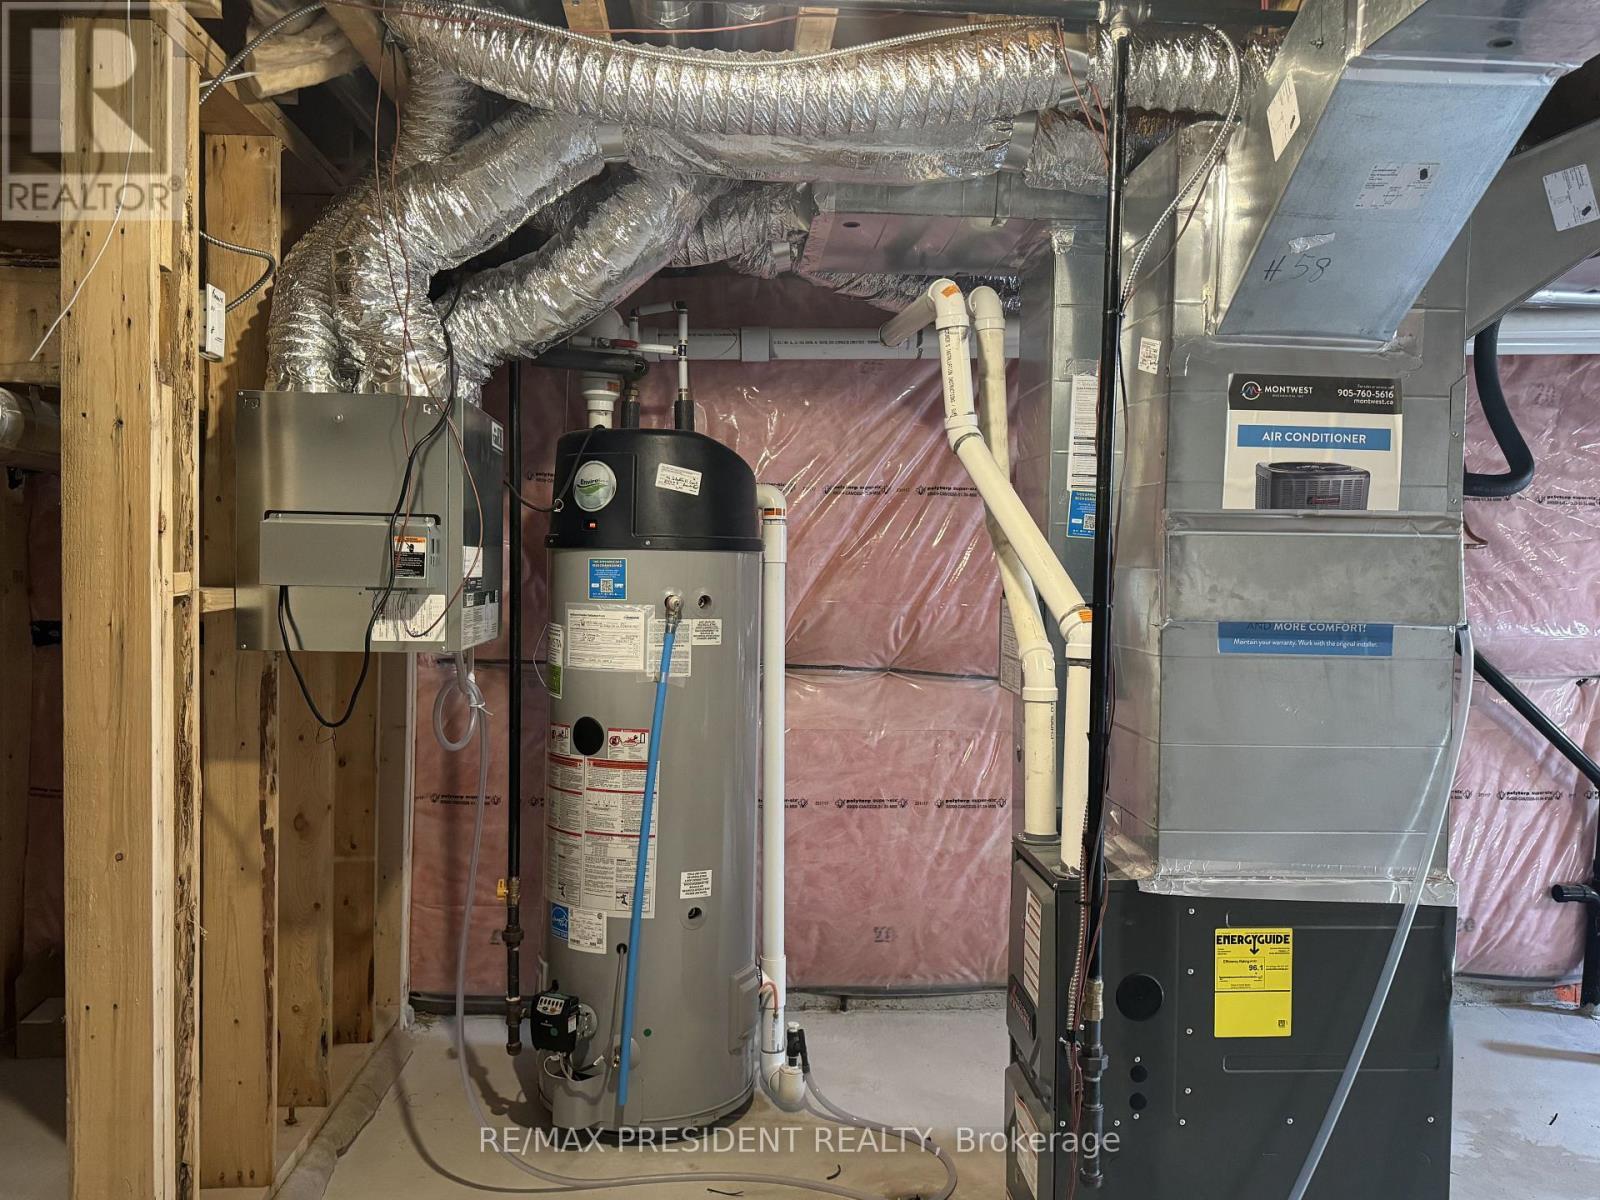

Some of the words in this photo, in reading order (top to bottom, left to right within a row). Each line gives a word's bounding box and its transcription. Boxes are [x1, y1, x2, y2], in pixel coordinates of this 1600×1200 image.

[1264, 385, 1313, 394] MONTWEST
[1337, 388, 1394, 399] 905-760-5616
[1262, 432, 1282, 442] AIR
[1284, 432, 1367, 444] CONDITIONER
[1274, 623, 1307, 631] MORE
[1309, 623, 1367, 633] COMFORT!
[1233, 638, 1258, 646] Maintain
[1313, 639, 1325, 647] with
[1216, 934, 1290, 945] ENERGYGUIDE
